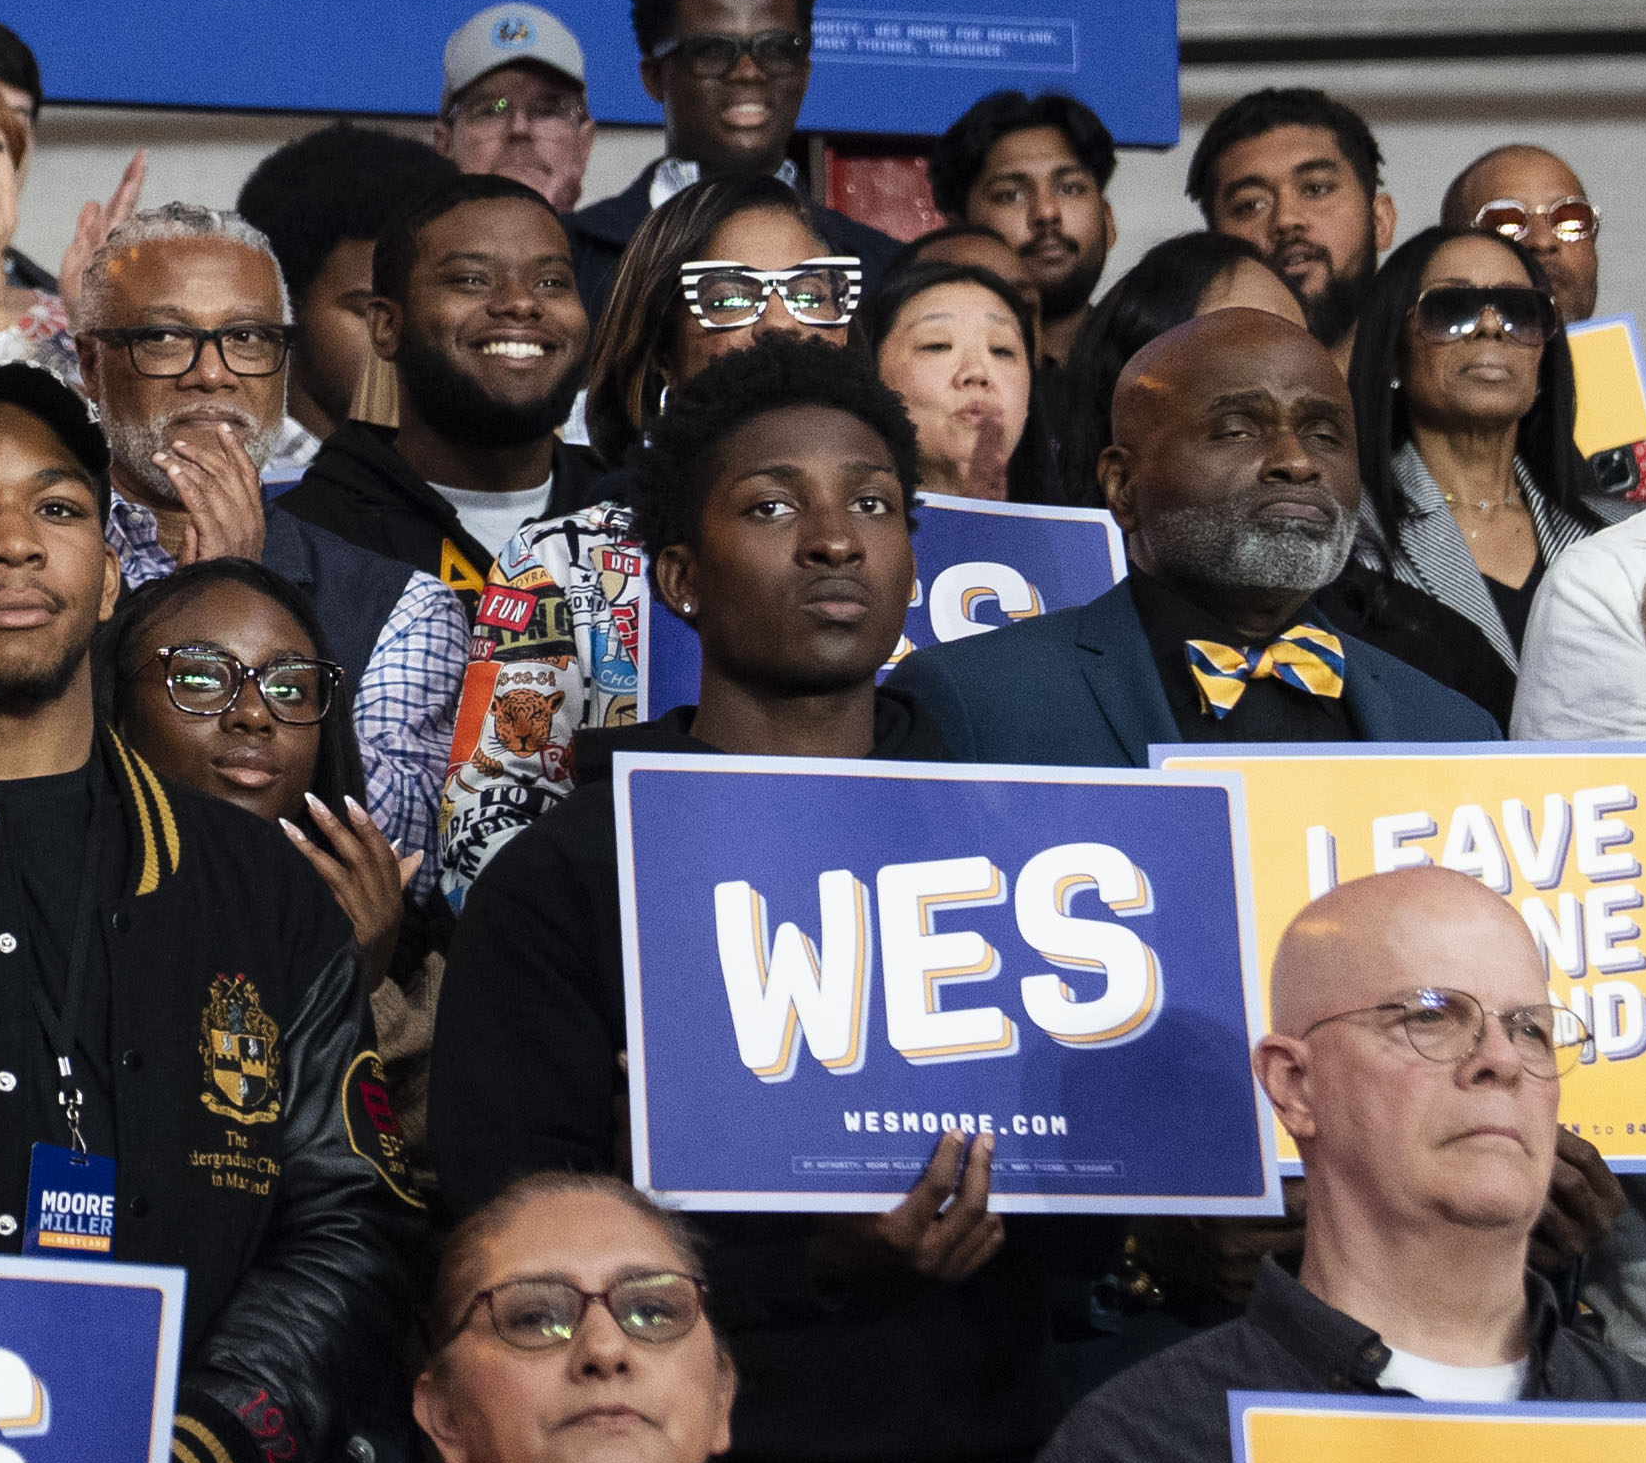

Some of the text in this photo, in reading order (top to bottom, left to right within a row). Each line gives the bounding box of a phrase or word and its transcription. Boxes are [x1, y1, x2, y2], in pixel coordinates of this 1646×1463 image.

[486, 595, 528, 624] FUN
[714, 842, 1164, 1084] WES
[843, 1111, 1068, 1136] WESMOORE.COM
[225, 1129, 248, 1149] The
[41, 1189, 115, 1217] MOORE
[39, 1212, 113, 1236] MILLER
